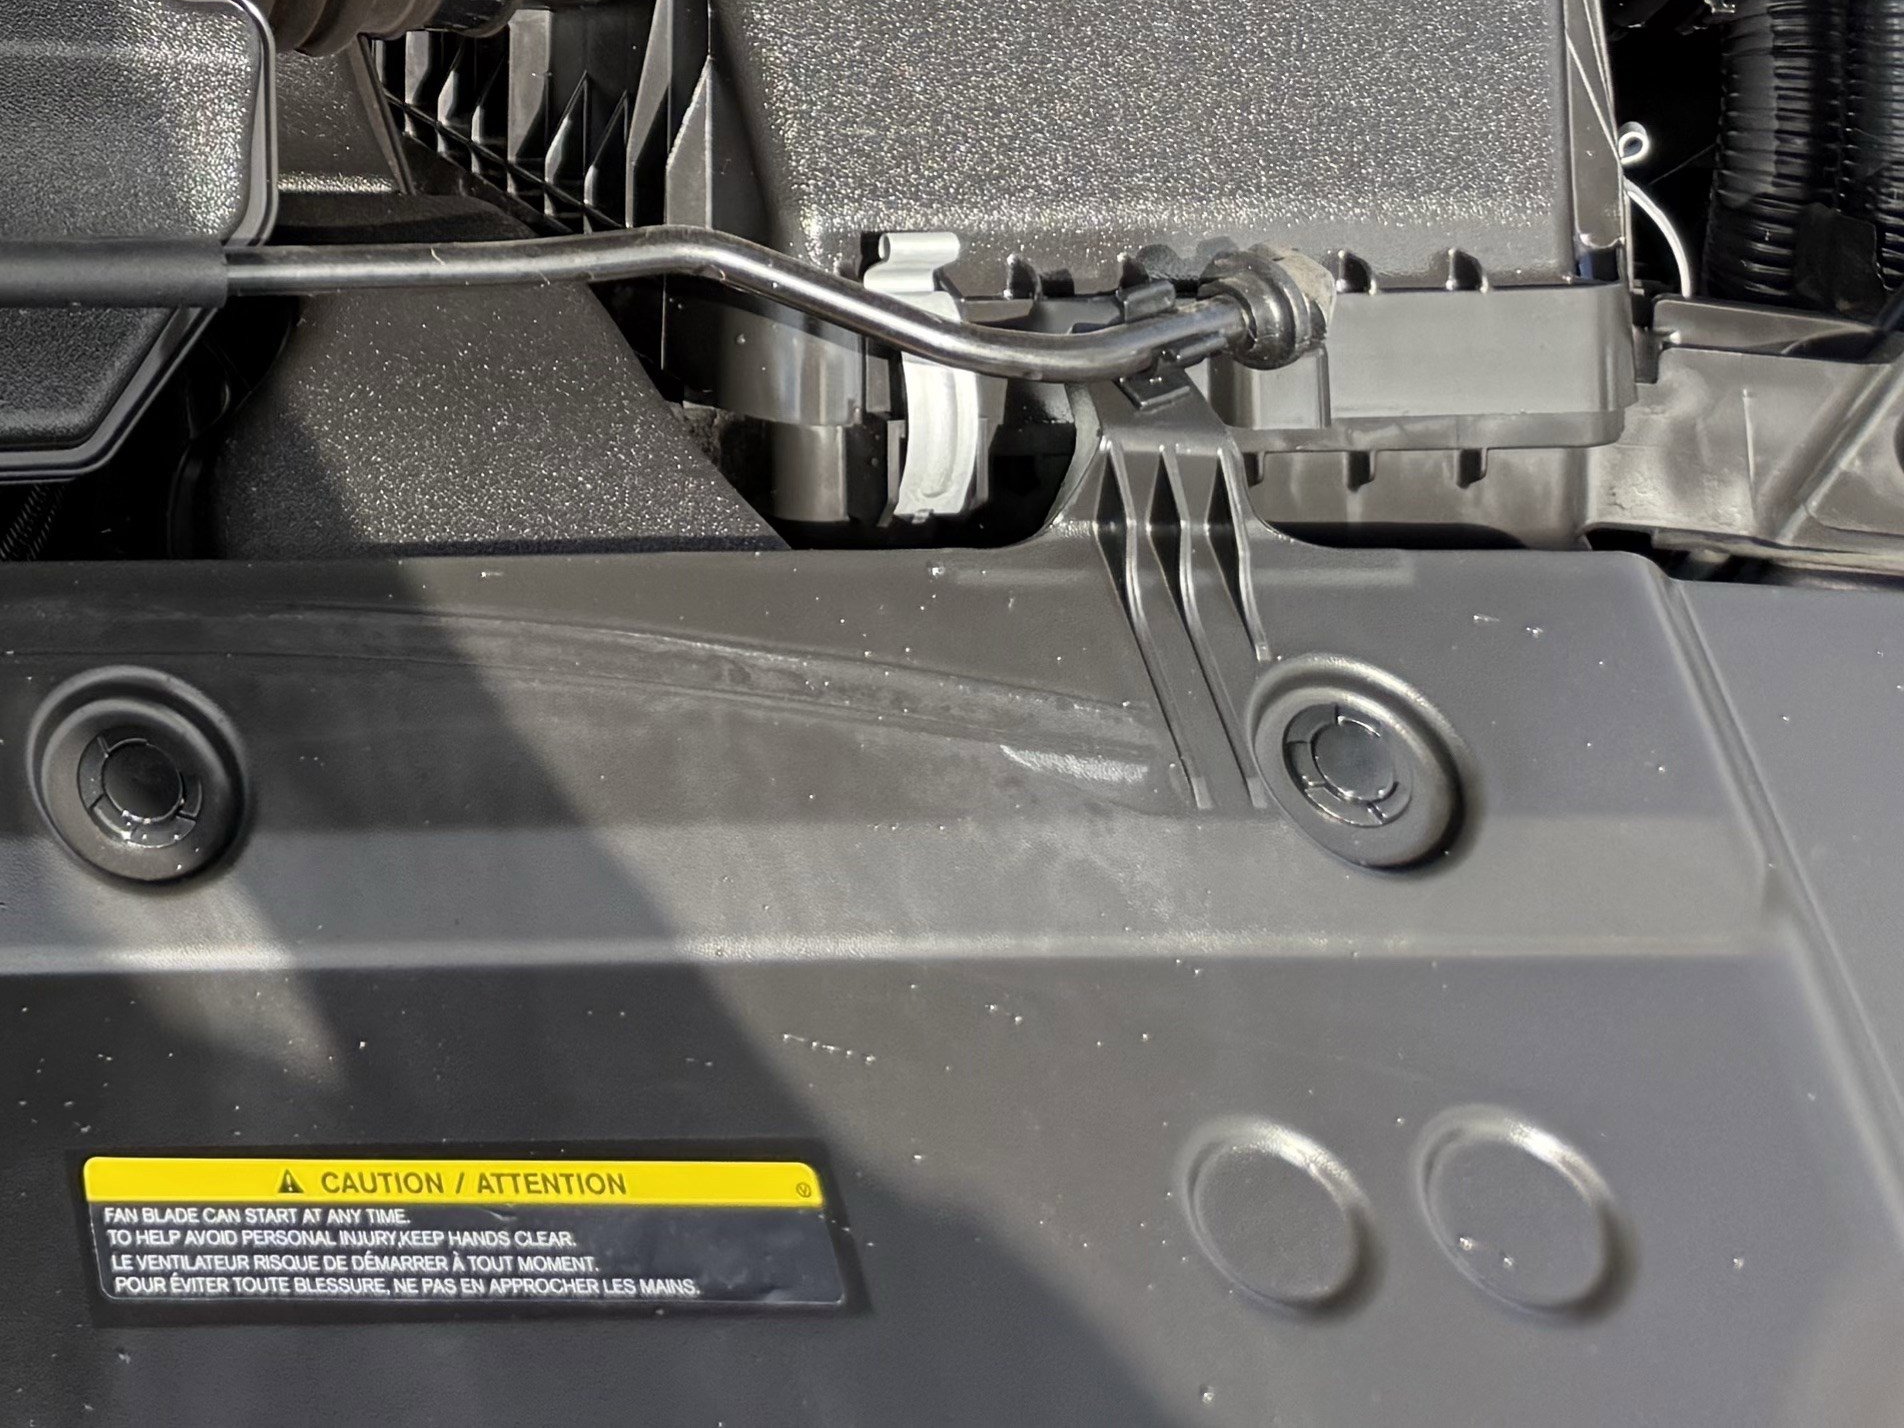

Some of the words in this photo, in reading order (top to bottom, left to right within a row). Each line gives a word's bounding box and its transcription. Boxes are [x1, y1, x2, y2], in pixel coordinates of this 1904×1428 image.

[320, 1171, 443, 1196] CAUTION
[454, 1171, 468, 1196] /
[477, 1171, 628, 1196] ATTENTION
[104, 1207, 139, 1225] FAN
[142, 1207, 200, 1225] BLADE
[202, 1207, 240, 1225] CAN
[244, 1207, 297, 1225] START
[301, 1207, 322, 1225] AT
[326, 1207, 362, 1225] ANY
[365, 1207, 411, 1225] TIME.
[108, 1230, 131, 1248] TO
[135, 1230, 182, 1248] HELP
[185, 1230, 238, 1248] AVOID
[242, 1230, 336, 1248] PERSONAL
[448, 1230, 511, 1248] HANDS
[515, 1230, 576, 1248] CLEAR.
[112, 1254, 132, 1272] LE
[135, 1254, 250, 1272] VENTILATEUR
[253, 1254, 320, 1275] RISQUE
[323, 1254, 348, 1272] DE
[351, 1249, 448, 1272] DÉMARRER
[468, 1254, 514, 1272] TOUT
[517, 1254, 599, 1272] MOMENT.
[115, 1278, 169, 1295] POUR
[170, 1273, 230, 1295] ÉVITER
[232, 1278, 292, 1295] TOUTE
[294, 1278, 391, 1298] BLESSURE,
[393, 1278, 418, 1295] NE
[421, 1278, 458, 1295] PAS
[461, 1278, 486, 1295] EN
[488, 1278, 599, 1295] APPROCHER
[602, 1278, 637, 1295] LES
[639, 1278, 700, 1295] MAINS.
